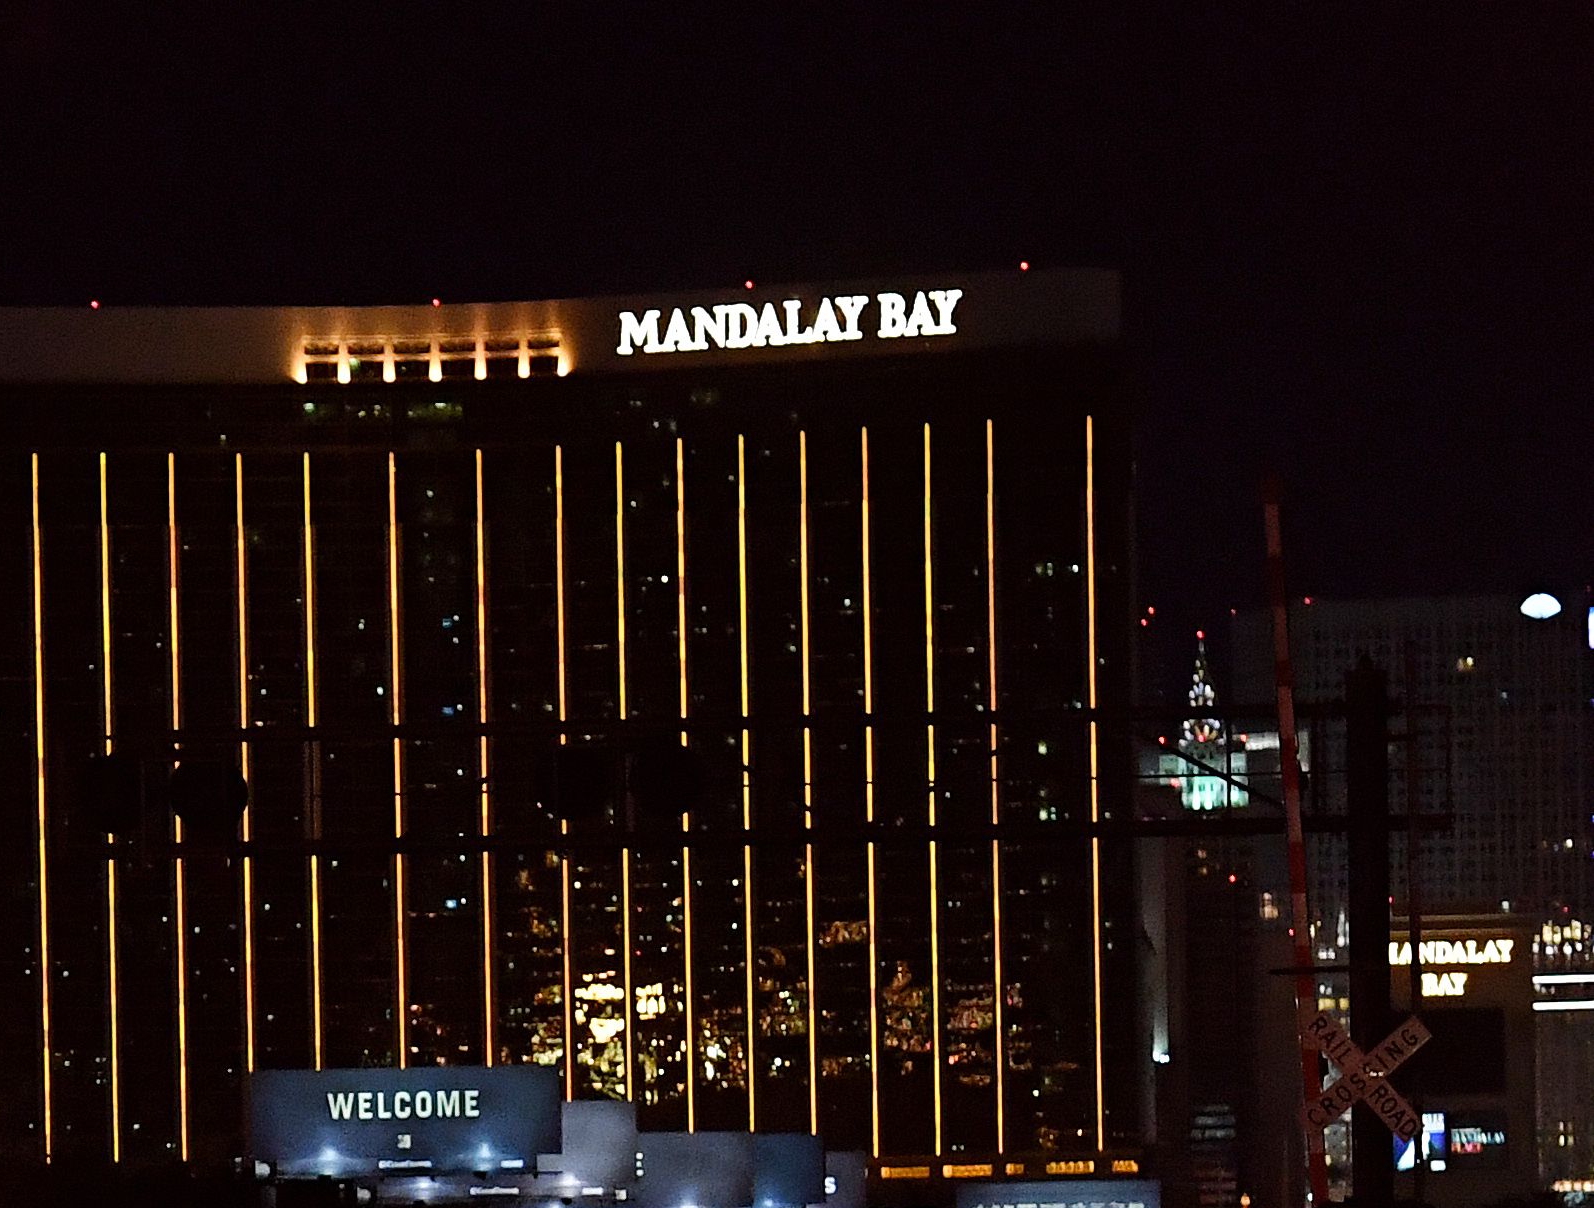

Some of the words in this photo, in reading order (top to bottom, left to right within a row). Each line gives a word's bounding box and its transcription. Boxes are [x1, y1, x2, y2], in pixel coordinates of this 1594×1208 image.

[616, 296, 869, 355] MANDALAY
[877, 289, 963, 338] BAY
[326, 1088, 481, 1121] WELCOME
[1307, 1028, 1418, 1126] CROSSING
[1309, 1016, 1352, 1065] RAIL
[1368, 1085, 1417, 1139] ROAD
